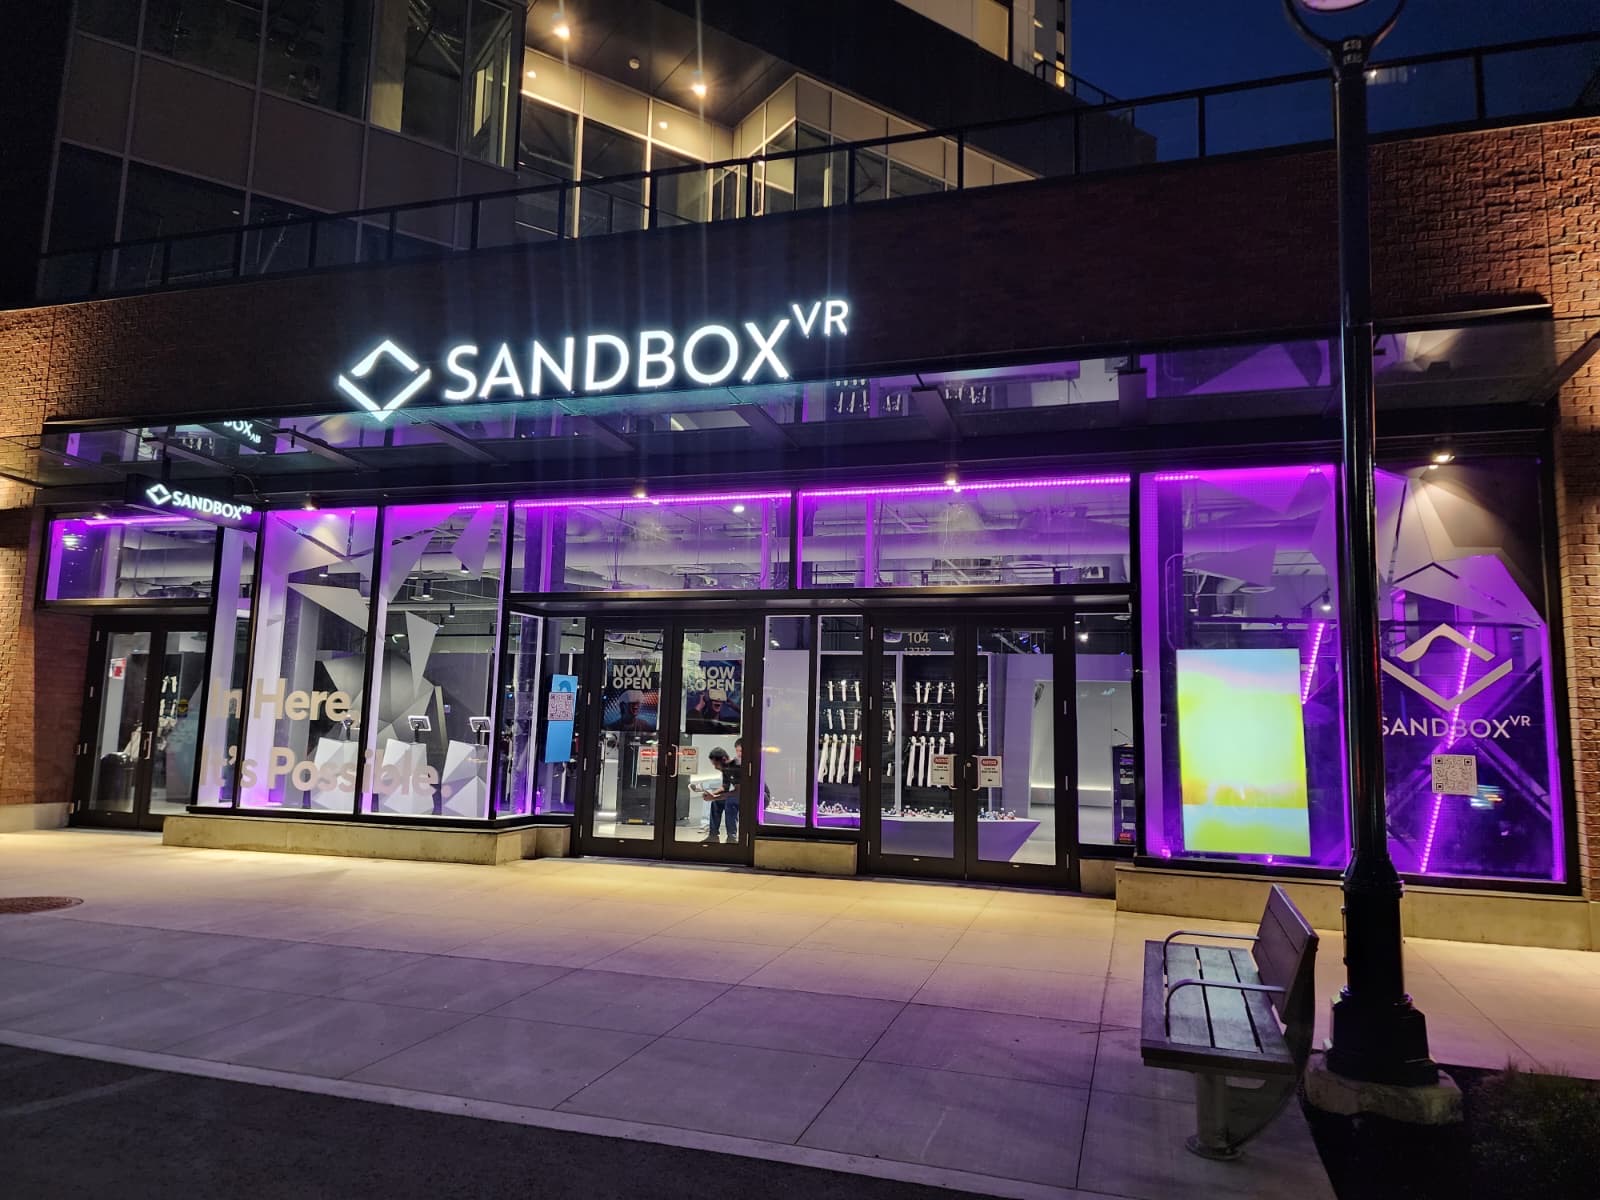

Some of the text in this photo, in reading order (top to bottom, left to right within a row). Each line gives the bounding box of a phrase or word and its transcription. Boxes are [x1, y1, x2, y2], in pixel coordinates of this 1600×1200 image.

[907, 631, 929, 643] 104
[612, 664, 652, 677] NOW
[694, 665, 735, 679] NOW
[612, 677, 652, 690] OPEN
[694, 679, 735, 692] OPEN
[210, 678, 242, 720] In
